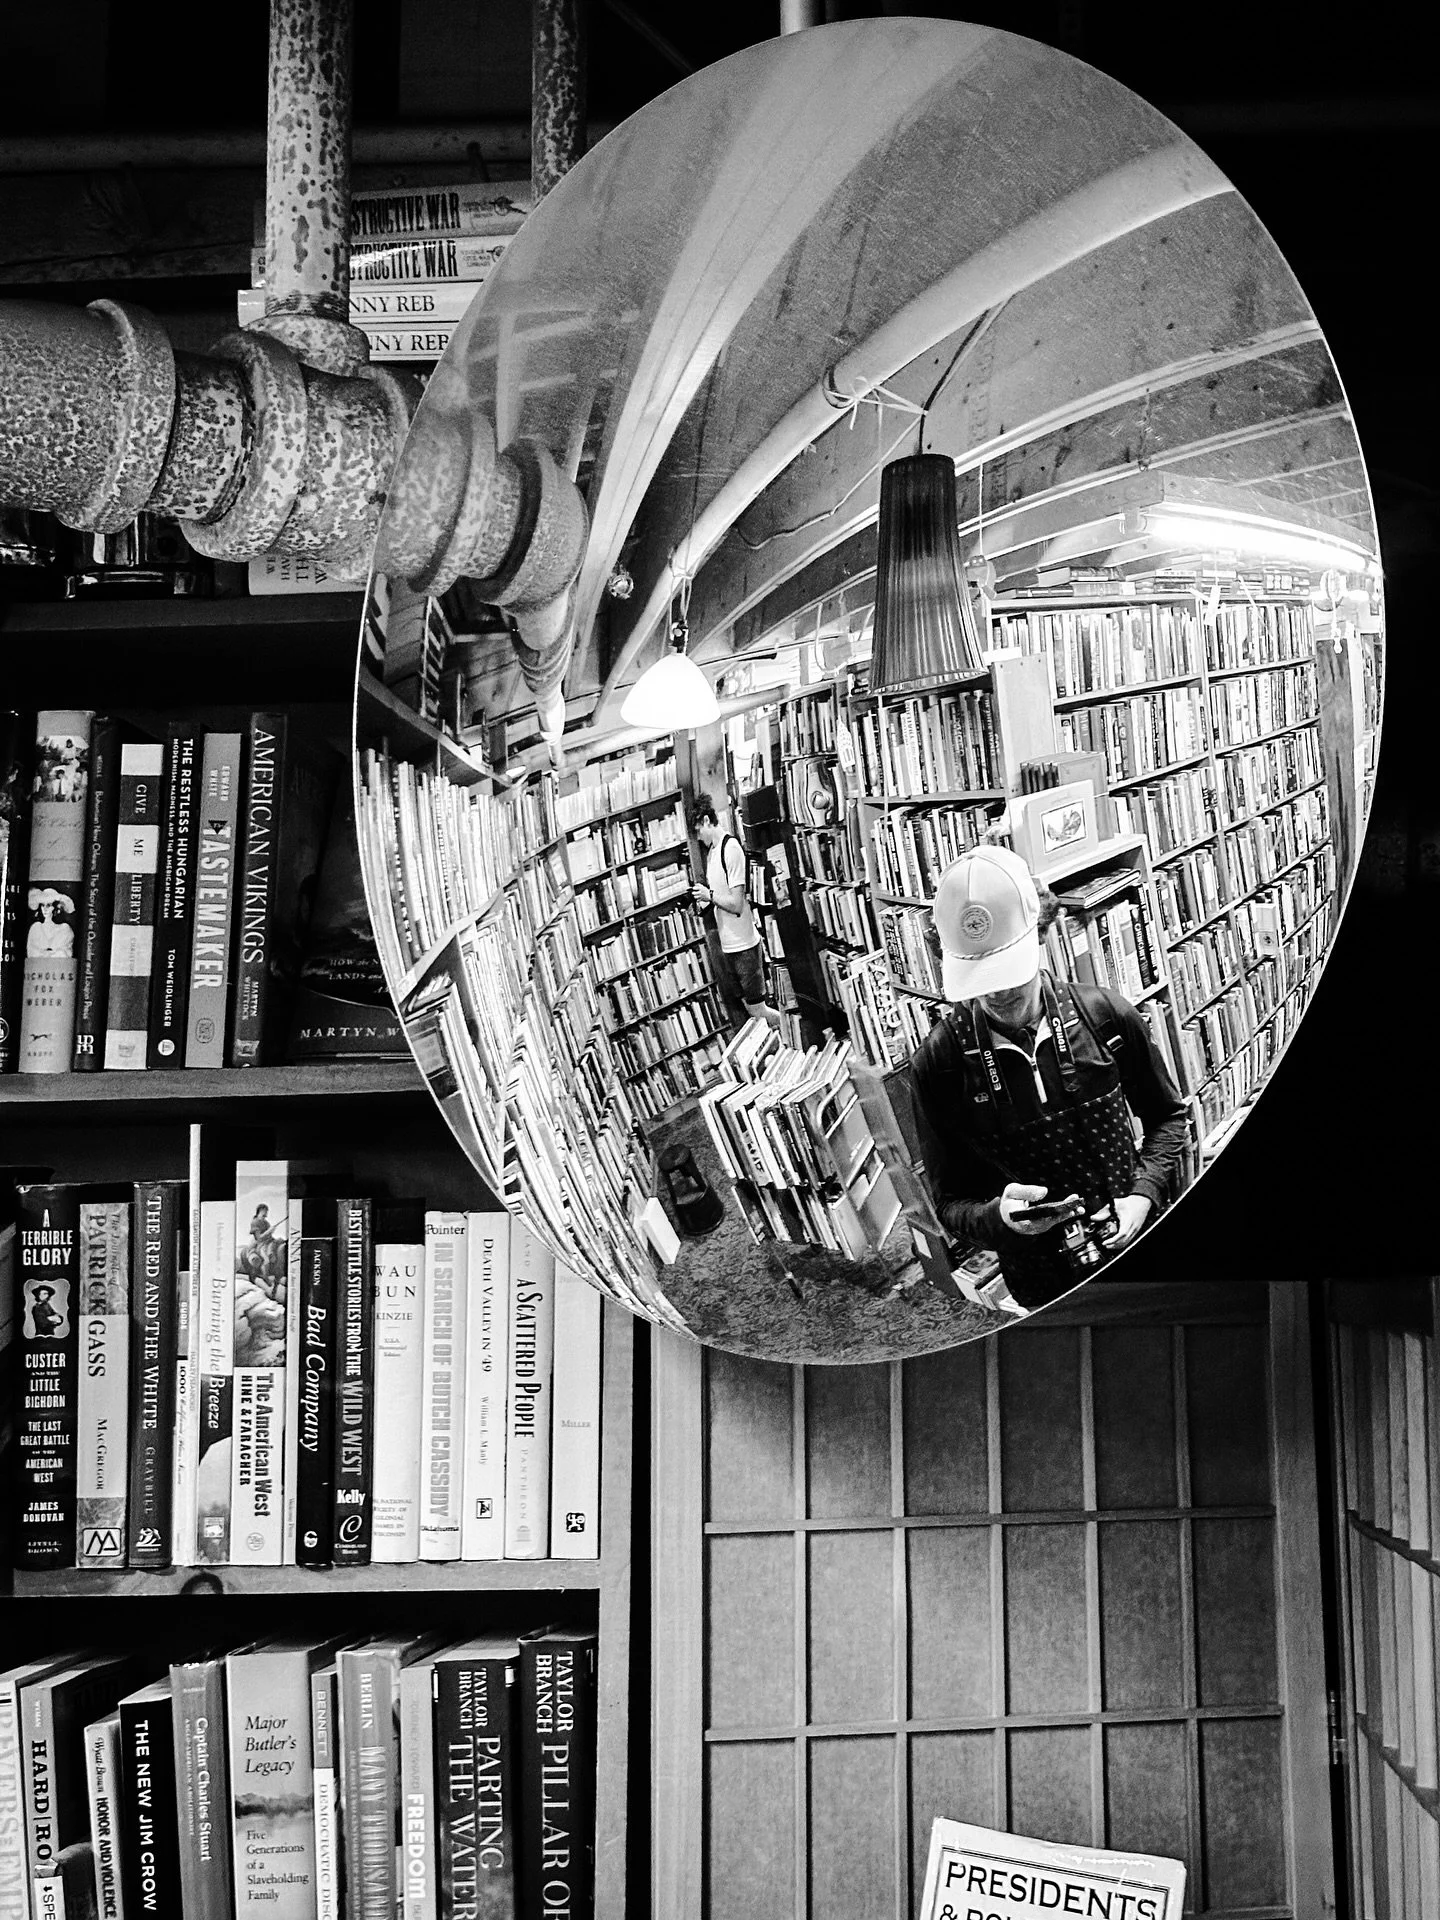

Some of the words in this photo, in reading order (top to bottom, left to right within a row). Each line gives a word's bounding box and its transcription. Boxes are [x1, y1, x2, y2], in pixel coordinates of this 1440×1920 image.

[427, 192, 461, 230] WAR
[423, 239, 459, 277] WAR
[397, 295, 435, 312] REB
[182, 739, 193, 764] THE
[135, 784, 147, 814] GIVE
[178, 770, 192, 833] RESTLESS
[208, 769, 219, 797] WHITE
[220, 765, 231, 801] EDWARD
[249, 729, 276, 856] AMERICAN
[133, 839, 144, 856] ME
[90, 873, 99, 887] The
[165, 855, 173, 890] AMERICAN
[174, 838, 188, 919] HUNGARIAN
[88, 888, 98, 907] Story
[89, 908, 97, 916] of
[129, 874, 142, 924] LIBERTY
[193, 826, 232, 989] TASTEMAKER
[242, 865, 269, 963] VIKINGS
[88, 918, 96, 930] the
[34, 985, 54, 993] FOX
[163, 971, 174, 1027] WEIDLINGER
[250, 981, 259, 1017] MARTYN
[300, 1027, 377, 1038] MARTYN
[43, 1209, 50, 1227] A
[145, 1195, 162, 1235] THE
[347, 1209, 362, 1235] BEST
[425, 1224, 465, 1235] Pointer
[21, 1230, 73, 1245] TERRIBLE
[289, 1227, 301, 1264] ANNA
[347, 1238, 362, 1274] LITTLE
[434, 1242, 453, 1262] IN
[23, 1248, 71, 1266] GLORY
[87, 1213, 108, 1315] PATRICK
[145, 1239, 161, 1278] RED
[313, 1249, 321, 1286] JACKSON
[482, 1238, 494, 1282] DEATH
[145, 1281, 160, 1319] AND
[347, 1276, 362, 1320] STORIES
[516, 1278, 532, 1288] A
[209, 1277, 227, 1343] Burning
[433, 1267, 453, 1340] SEARCH
[482, 1284, 494, 1334] VALLEY
[143, 1321, 160, 1360] THE
[305, 1305, 326, 1347] Bad
[346, 1322, 363, 1353] FROM
[482, 1336, 493, 1351] IN
[516, 1292, 543, 1378] SCATTERED
[25, 1353, 66, 1368] CUSTER
[87, 1319, 107, 1378] GASS
[210, 1347, 226, 1371] the
[345, 1354, 362, 1376] THE
[432, 1344, 452, 1366] OF
[481, 1353, 494, 1373] '49
[30, 1378, 60, 1392] LITTLE
[142, 1364, 159, 1430] WHITE
[179, 1365, 187, 1394] 1000
[241, 1375, 252, 1404] HINE
[255, 1372, 275, 1402] The
[25, 1395, 66, 1408] BIGHORN
[207, 1376, 227, 1430] Breeze
[241, 1408, 252, 1416] &
[299, 1353, 326, 1452] Company
[342, 1380, 363, 1425] WILD
[431, 1370, 453, 1432] BUTCH
[480, 1396, 489, 1427] William
[515, 1382, 542, 1438] PEOPLE
[20, 1435, 41, 1445] GREAT
[43, 1434, 70, 1445] BATTLE
[28, 1421, 41, 1431] THE
[43, 1421, 62, 1431] LAST
[254, 1404, 274, 1476] American
[25, 1458, 63, 1468] AMERICAN
[240, 1419, 252, 1486] FARAGHER
[341, 1428, 363, 1476] WEST
[33, 1472, 54, 1483] WEST
[144, 1446, 156, 1514] GRAYBILL
[429, 1435, 452, 1517] CASSIDY
[520, 1449, 529, 1520] PANTHEON
[28, 1501, 59, 1511] JAMES
[253, 1478, 272, 1517] West
[336, 1489, 366, 1506] Kelly
[23, 1513, 64, 1522] DONOVAN
[359, 1673, 375, 1729] BERLIN
[459, 1671, 474, 1730] BRANCH
[474, 1668, 488, 1729] TAYLOR
[536, 1654, 553, 1734] BRANCH
[556, 1651, 574, 1732] TAYLOR
[134, 1720, 149, 1757] THE
[193, 1717, 209, 1766] Captain
[245, 1715, 289, 1733] Major
[316, 1689, 328, 1757] BENNETT
[245, 1735, 297, 1752] Butler's
[32, 1739, 51, 1814] HARD
[136, 1763, 152, 1807] NEW
[245, 1758, 296, 1776] Legacy
[449, 1735, 475, 1803] THE
[198, 1770, 212, 1819] Charles
[477, 1736, 504, 1869] PARTING
[542, 1741, 571, 1872] PILLAR
[96, 1797, 110, 1836] HONOR
[139, 1813, 154, 1846] JIM
[246, 1830, 266, 1840] Five
[319, 1783, 331, 1884] DEMOCRATIC
[36, 1823, 52, 1861] RO
[100, 1839, 113, 1863] AND
[199, 1821, 213, 1862] Stuart
[246, 1842, 305, 1855] Generations
[407, 1793, 426, 1899] FREEDOM
[140, 1854, 157, 1911] CROW
[246, 1860, 257, 1870] of
[259, 1862, 265, 1870] a
[247, 1873, 310, 1886] Slaveholding
[101, 1863, 117, 1919] VIOLENCE
[248, 1890, 280, 1902] Family
[945, 1861, 1157, 1920] PRESIDENTS
